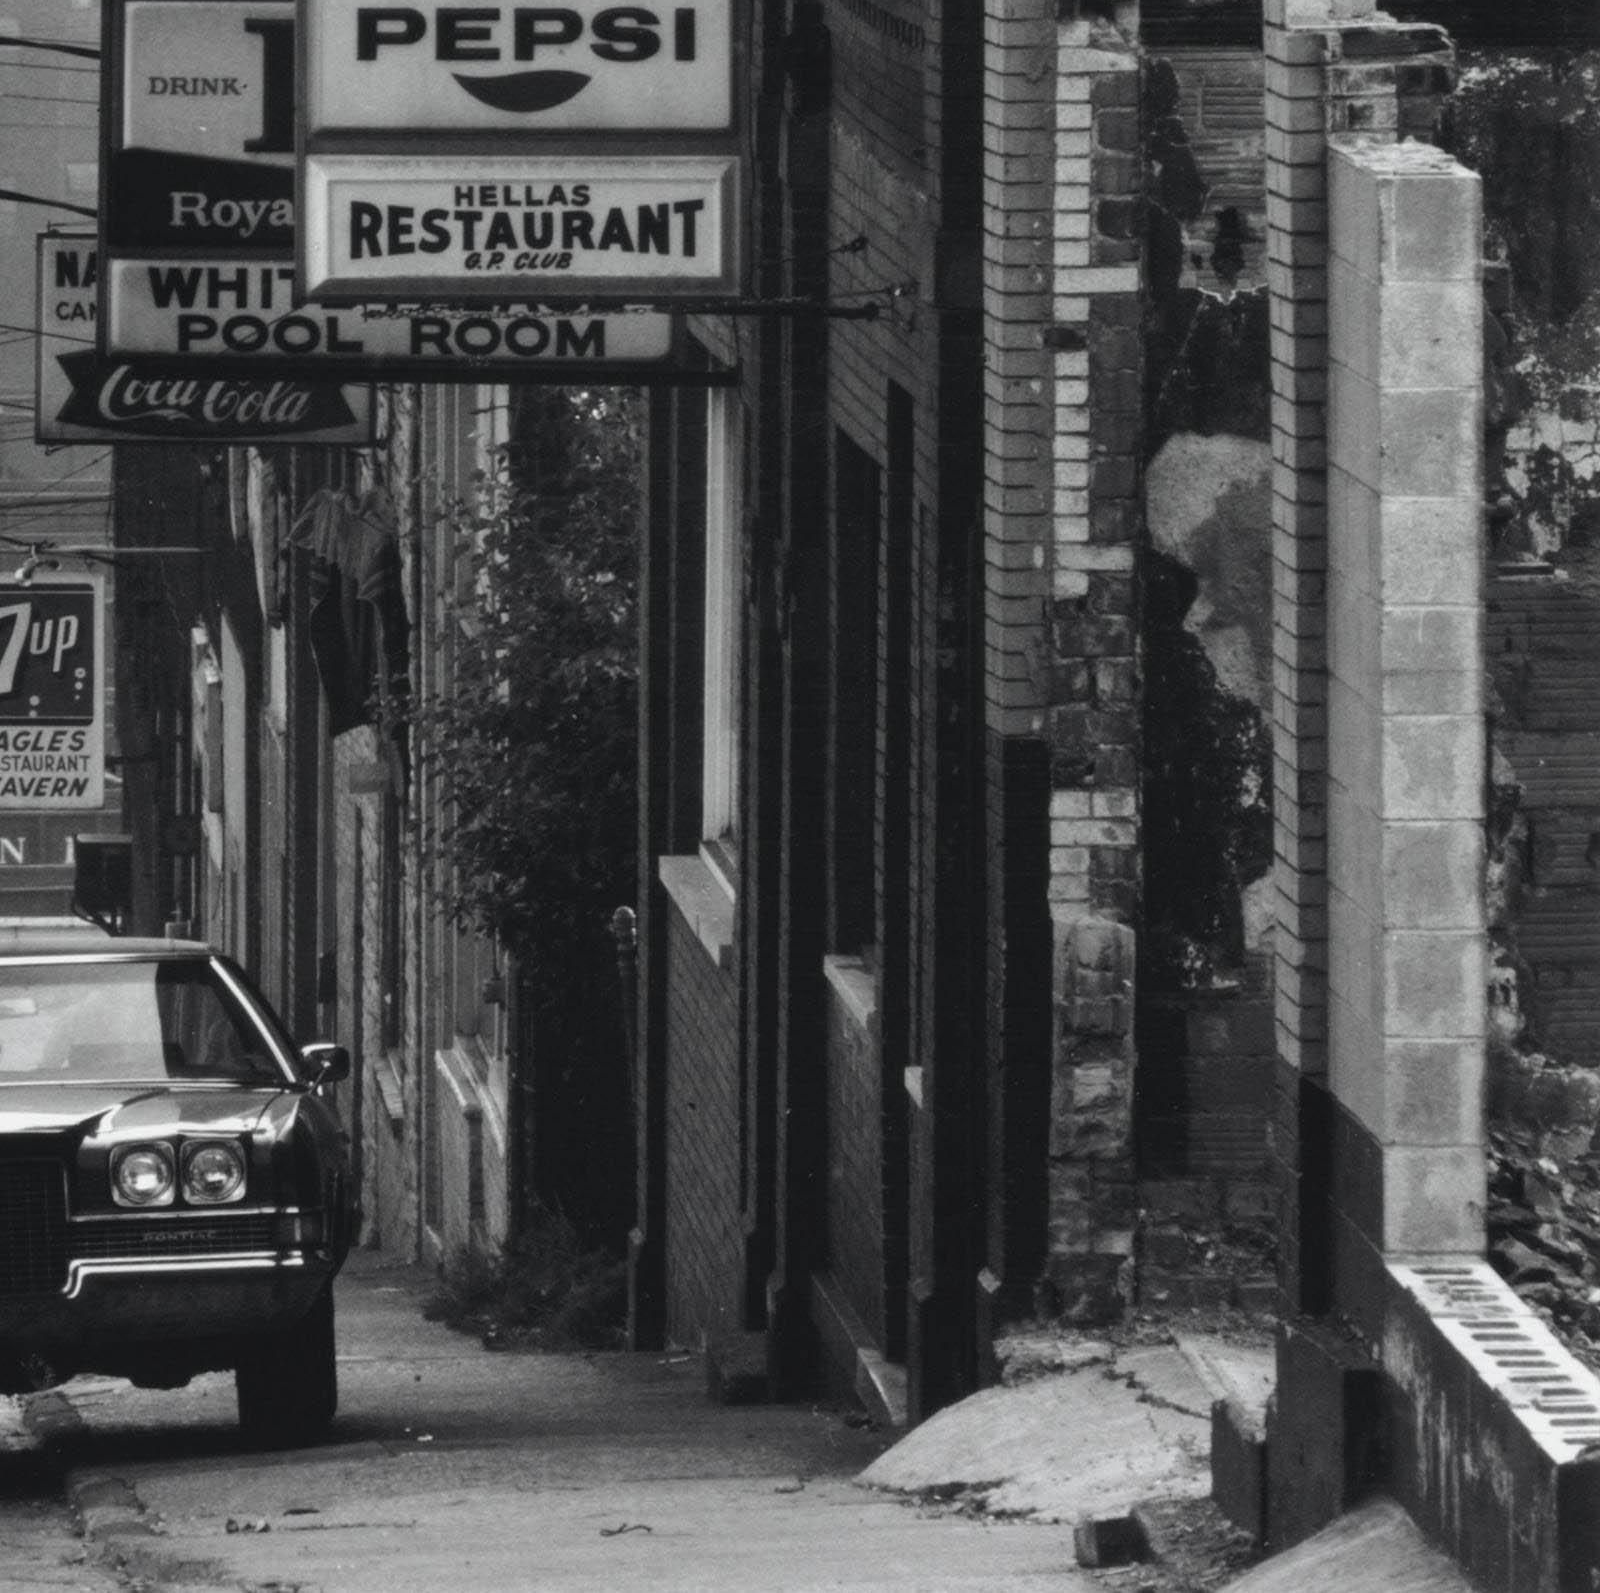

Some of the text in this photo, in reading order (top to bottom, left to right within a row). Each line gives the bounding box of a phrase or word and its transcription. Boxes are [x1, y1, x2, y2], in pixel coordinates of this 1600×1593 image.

[356, 6, 696, 63] PEPSI
[148, 76, 239, 97] DRINK
[454, 184, 591, 208] HELLAS
[350, 200, 705, 261] RESTAURANT
[513, 252, 573, 271] CLUB
[177, 316, 606, 358] POOL ROOM
